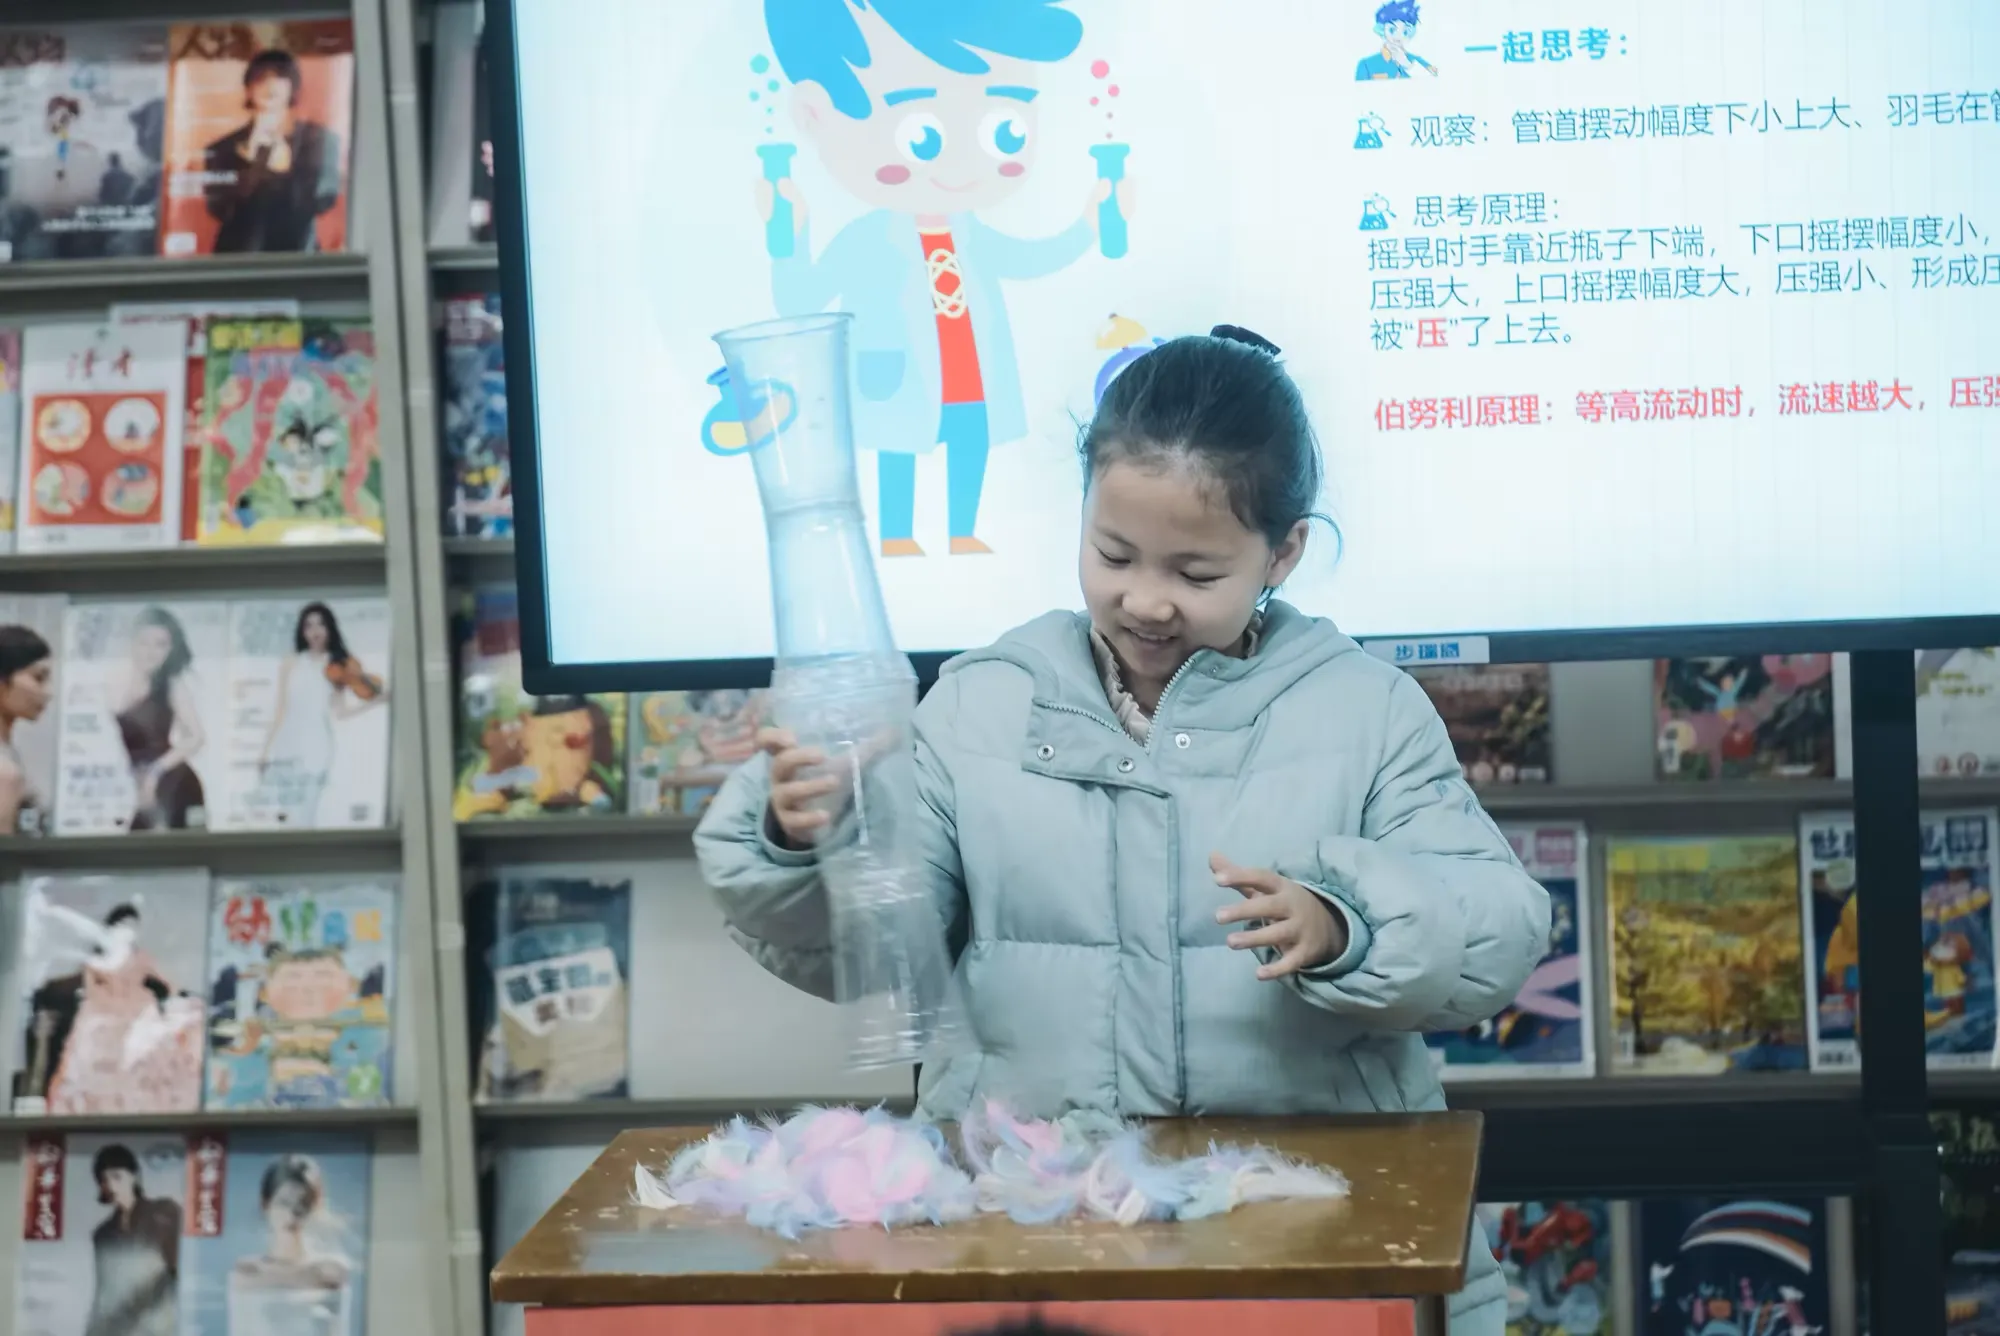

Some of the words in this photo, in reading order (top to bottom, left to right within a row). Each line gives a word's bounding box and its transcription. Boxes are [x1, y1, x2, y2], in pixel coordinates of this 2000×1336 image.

[1464, 27, 1627, 63] 一起思考：
[1413, 192, 1560, 227] 思考原理：
[1368, 212, 1989, 271] 摇晃时手靠近瓶子下端，下口摇摆幅度小，
[1370, 312, 1571, 351] 被“压”了上去。
